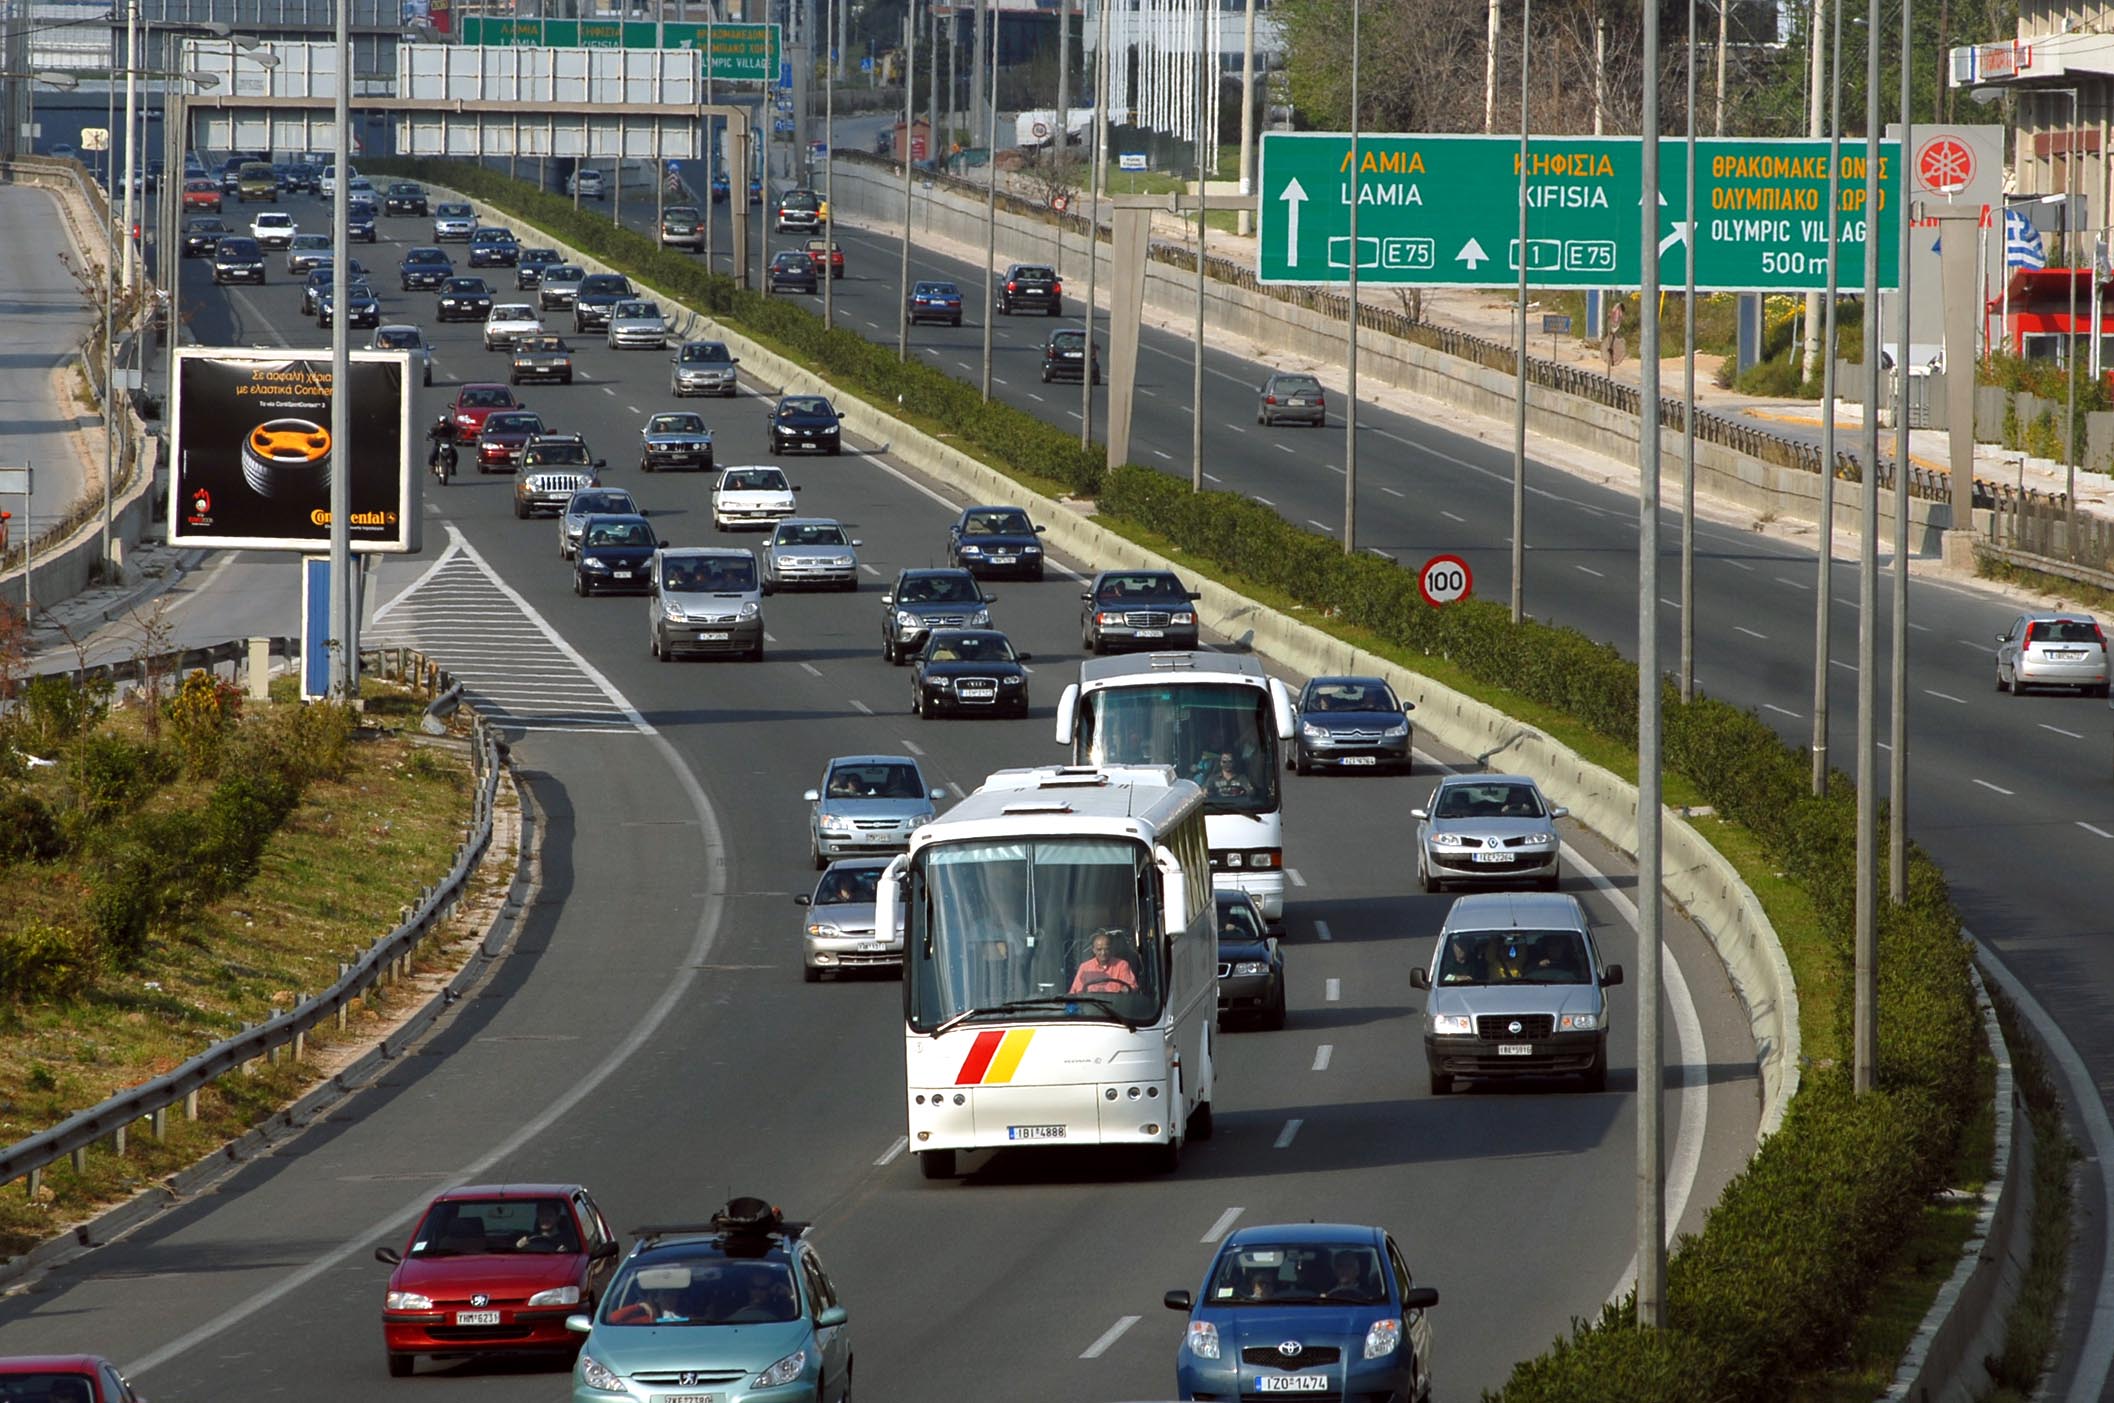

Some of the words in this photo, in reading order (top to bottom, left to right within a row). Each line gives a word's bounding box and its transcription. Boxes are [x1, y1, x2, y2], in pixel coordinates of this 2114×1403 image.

[1339, 151, 1426, 174] ΛΑΜΙΑ
[1341, 183, 1423, 206] LAMIA
[1712, 187, 1819, 210] ΟΛΥΜΠΙΑΚΟ
[1711, 219, 1791, 242] OLYMPIC
[1800, 220, 1867, 242] VILAG
[1532, 245, 1539, 264] 1
[1428, 570, 1463, 592] 100
